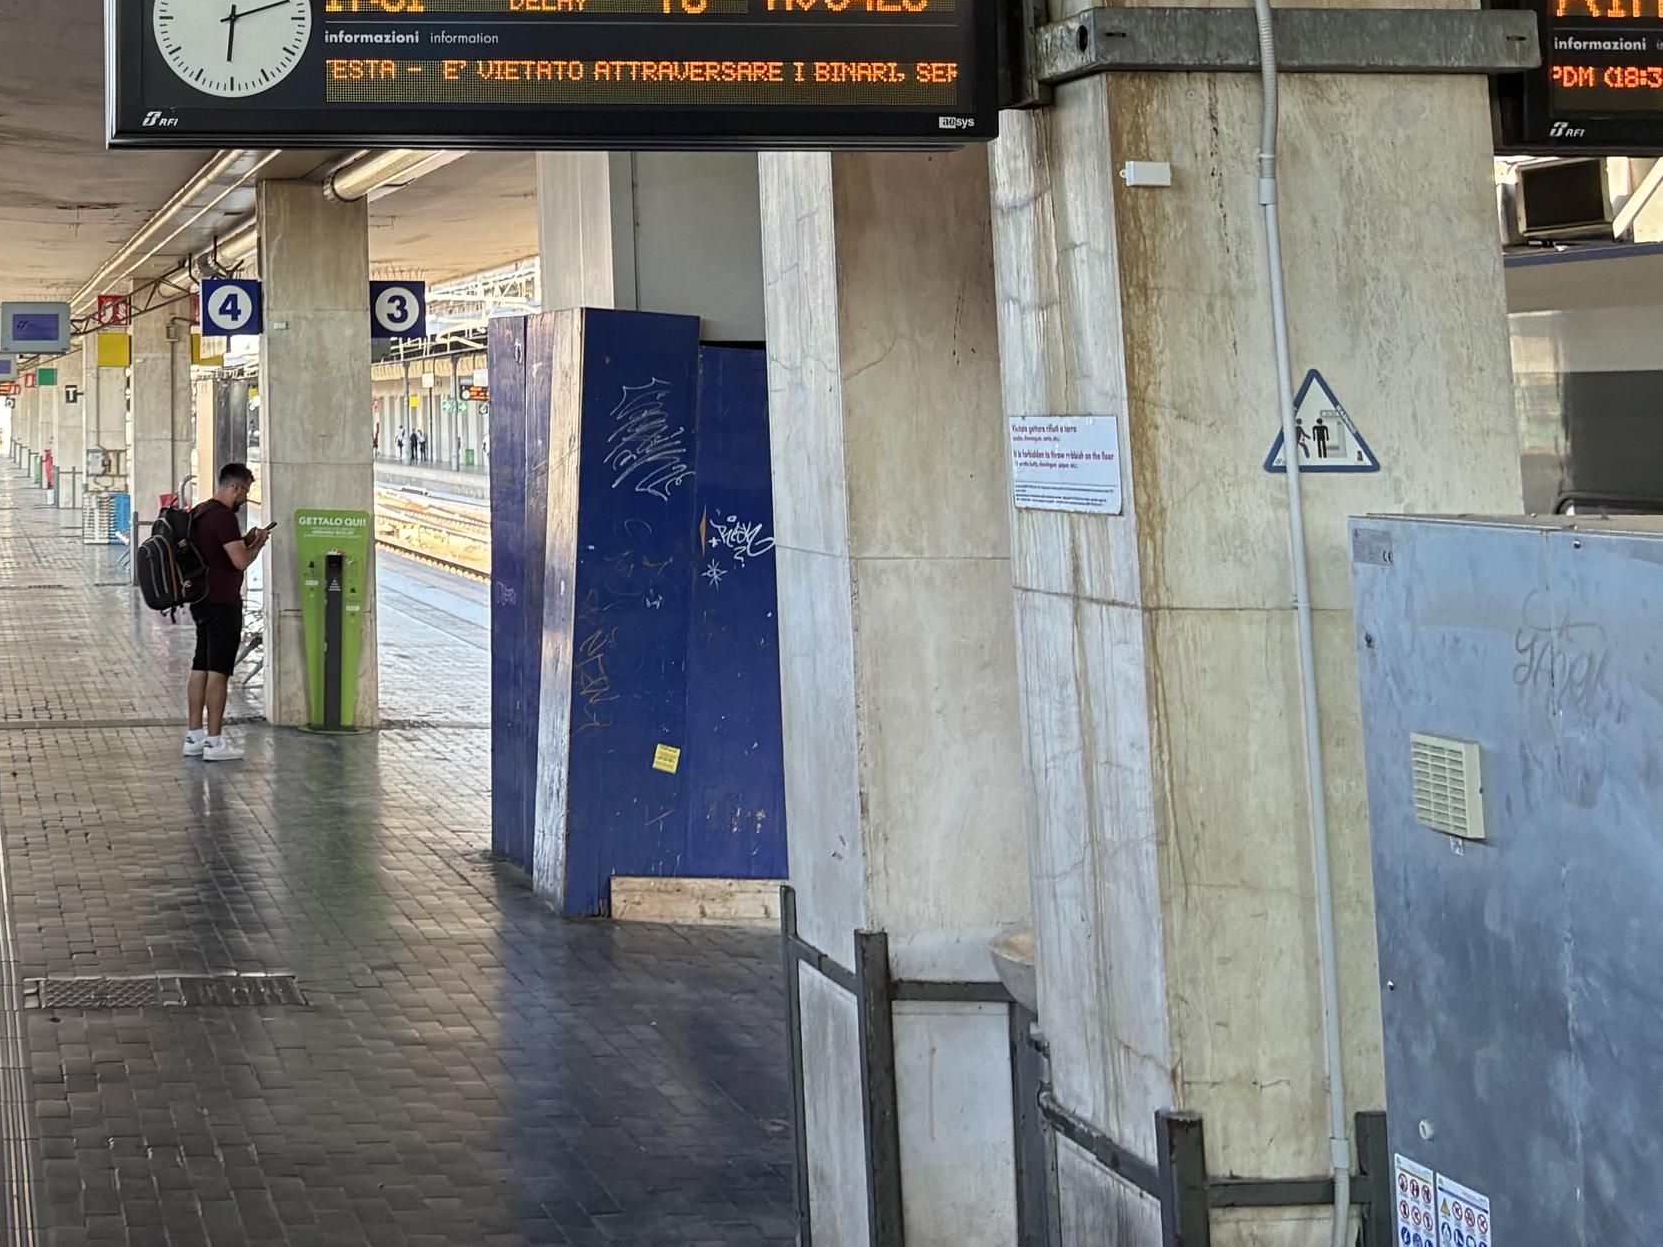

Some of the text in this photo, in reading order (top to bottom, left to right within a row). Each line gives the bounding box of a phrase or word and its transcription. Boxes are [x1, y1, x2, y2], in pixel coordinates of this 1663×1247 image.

[324, 30, 499, 45] informazioni information
[1554, 37, 1646, 50] informazioni
[477, 60, 585, 81] VIETATO
[593, 60, 784, 83] ATTRAVERSARE
[793, 62, 806, 82] I
[158, 118, 178, 127] RFI
[1565, 128, 1586, 138] RFI
[218, 293, 242, 322] 4
[386, 295, 409, 324] 3
[299, 516, 343, 527] GETTALO
